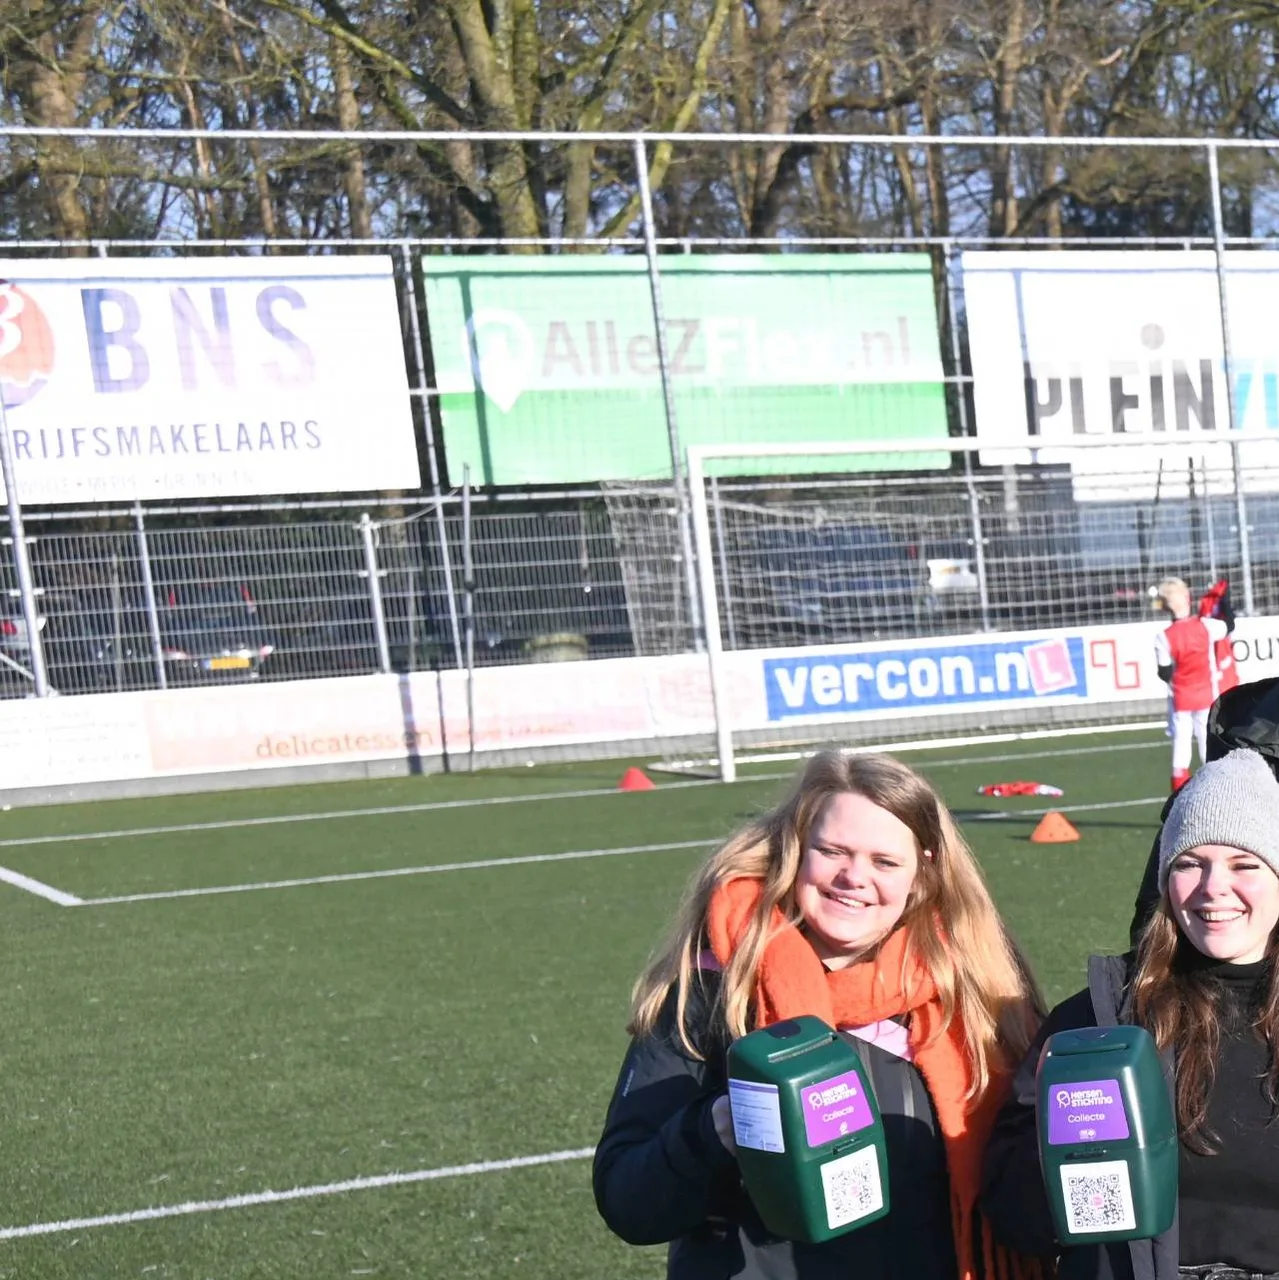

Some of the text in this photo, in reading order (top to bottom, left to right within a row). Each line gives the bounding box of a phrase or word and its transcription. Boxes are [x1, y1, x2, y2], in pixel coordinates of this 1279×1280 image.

[81, 284, 317, 394] BNS
[12, 419, 323, 460] RIJFSMAKELAARS
[1067, 1113, 1106, 1124] Collecte
